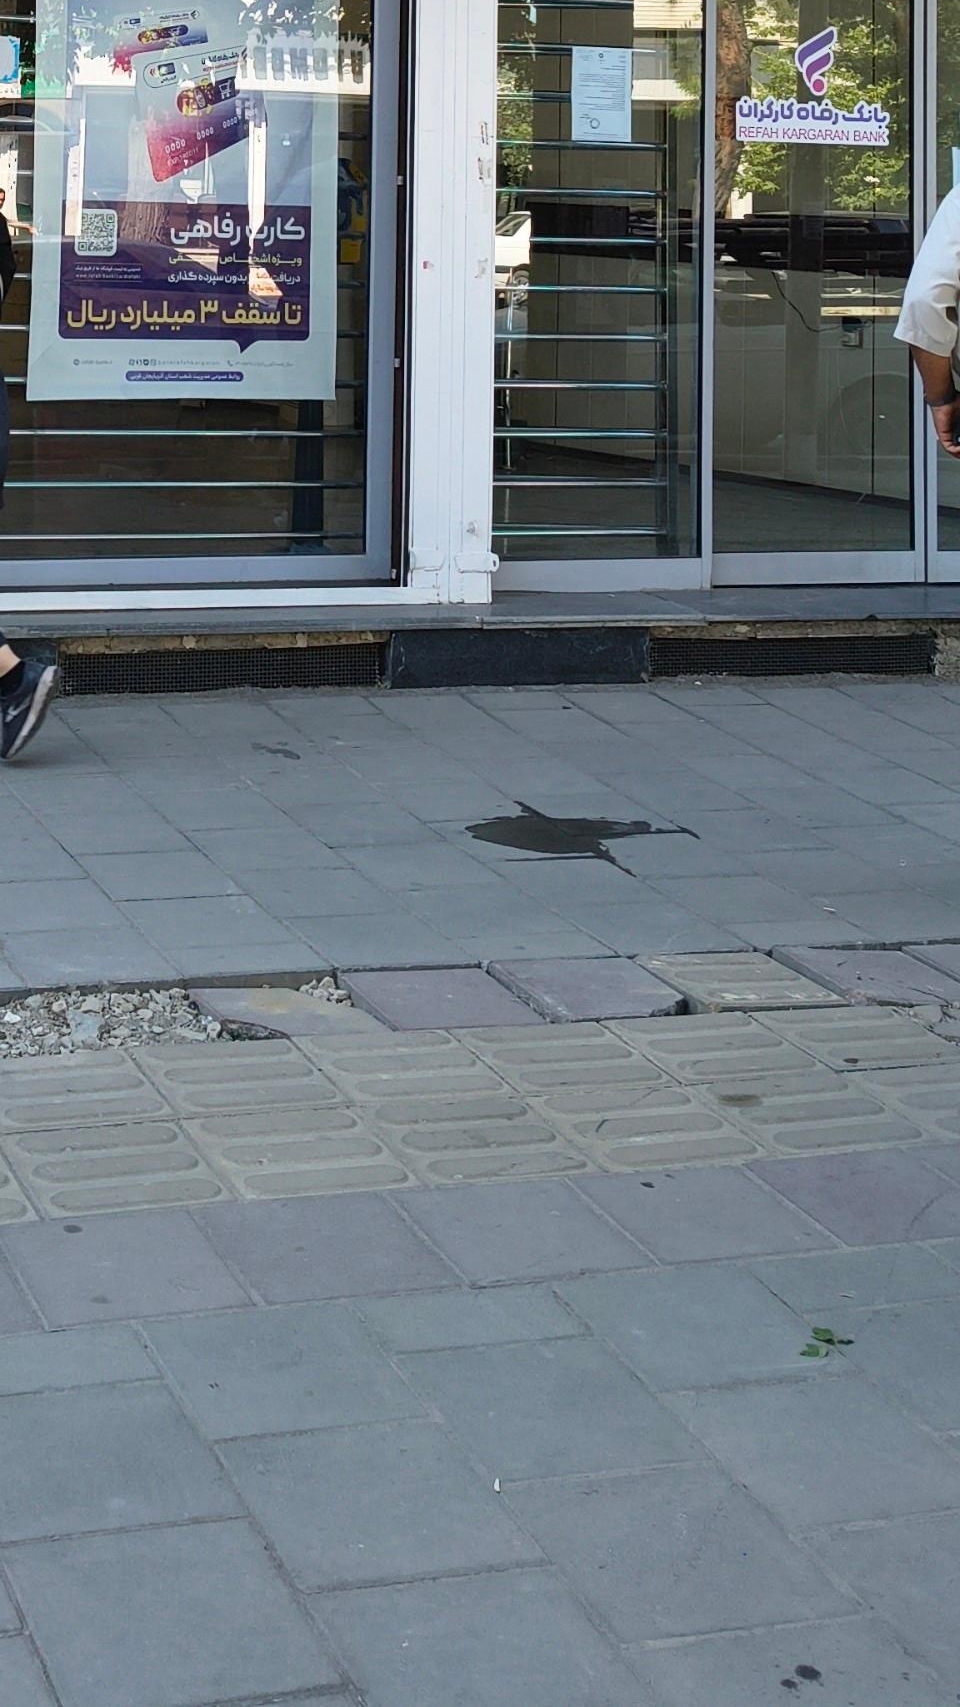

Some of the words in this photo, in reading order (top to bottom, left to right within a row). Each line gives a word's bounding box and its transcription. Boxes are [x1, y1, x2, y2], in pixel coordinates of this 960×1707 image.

[739, 99, 794, 122] کارگران
[796, 102, 839, 125] رفاه
[842, 105, 888, 129] بانک
[738, 126, 779, 139] REFAH
[782, 128, 850, 141] KARGARAN
[853, 130, 886, 143] BANK
[170, 212, 241, 247] رفاهی
[272, 253, 303, 267] ویژه
[198, 273, 224, 286] سپرده
[224, 273, 248, 285] بدون
[66, 299, 117, 330] ریال
[120, 300, 196, 330] میلیارد
[199, 299, 219, 324] ۳
[222, 301, 281, 325] سقف
[284, 301, 302, 325] تا
